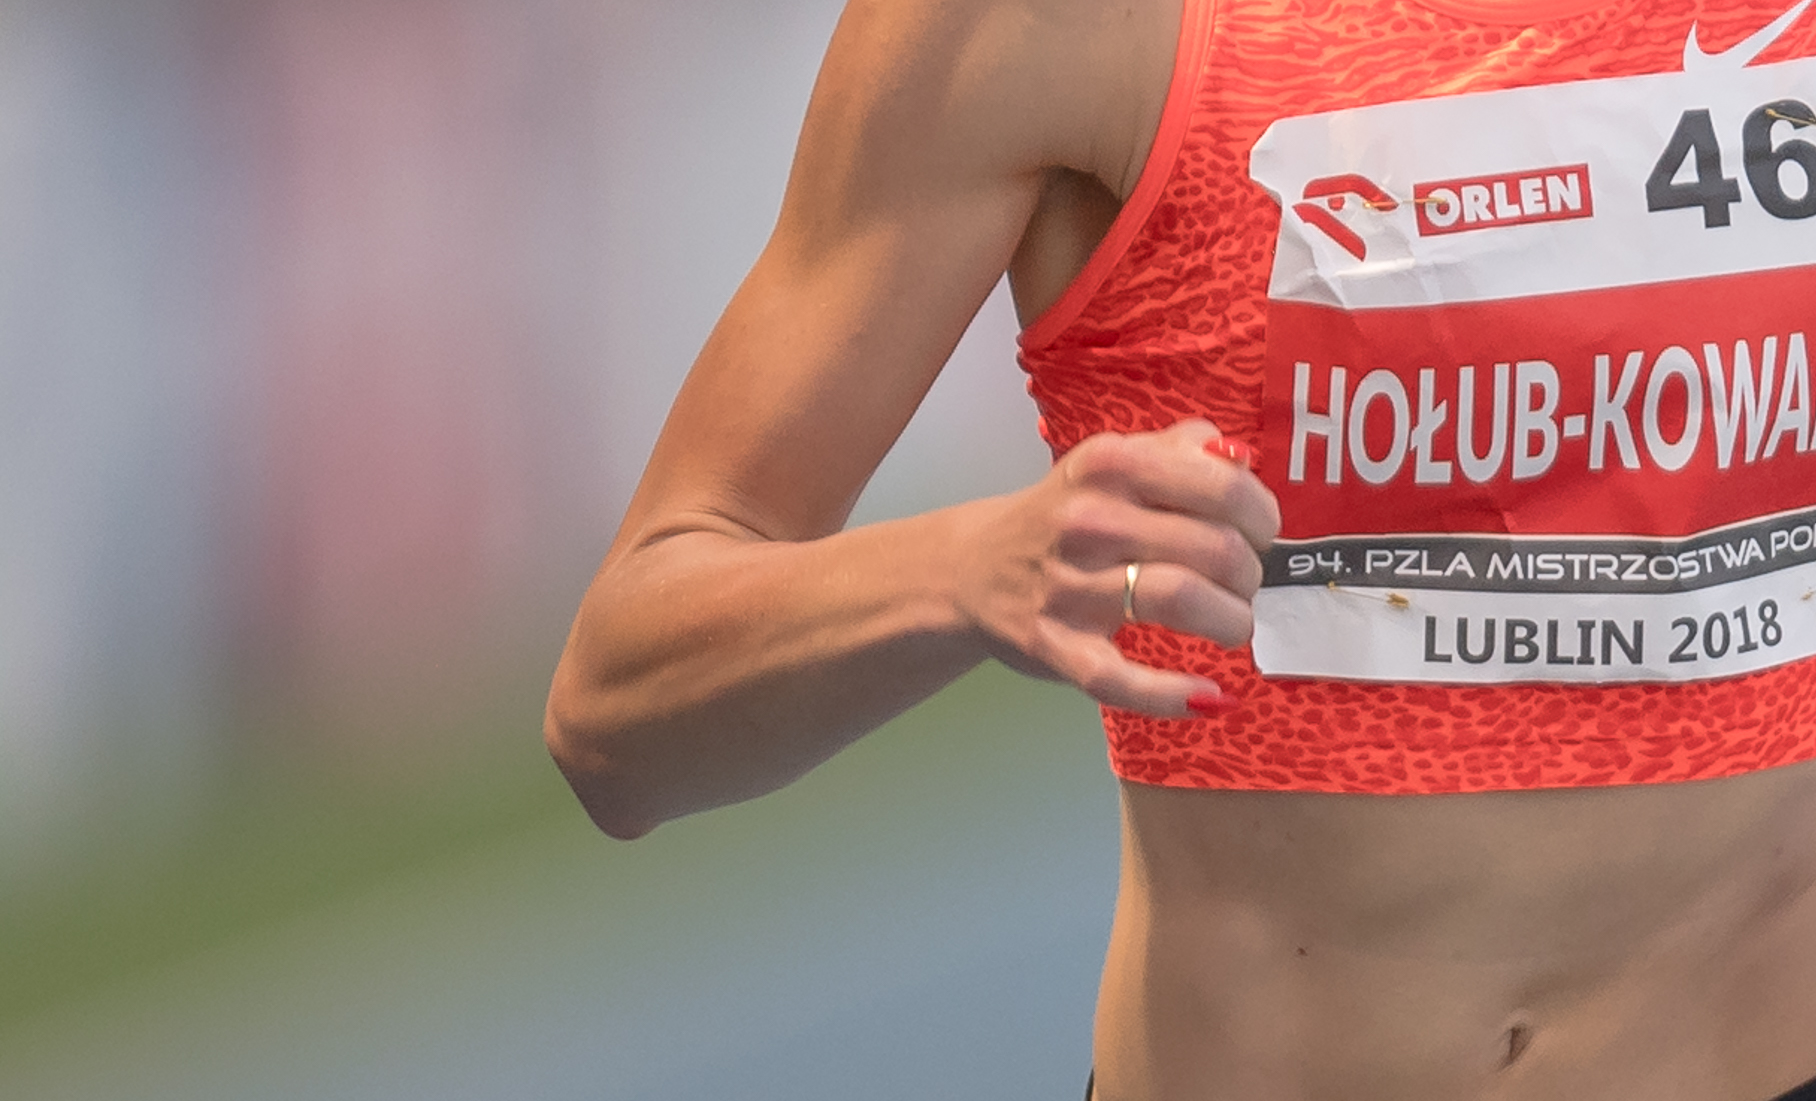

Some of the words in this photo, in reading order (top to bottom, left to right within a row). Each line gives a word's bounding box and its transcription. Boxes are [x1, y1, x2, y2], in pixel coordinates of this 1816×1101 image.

[1424, 172, 1582, 227] ORLEN
[1287, 553, 1352, 578] 94.
[1365, 549, 1476, 580] PZLA
[1486, 539, 1766, 581] MISTRZOSTWA
[1423, 615, 1645, 666] LUBLIN
[1668, 598, 1783, 665] 2018
